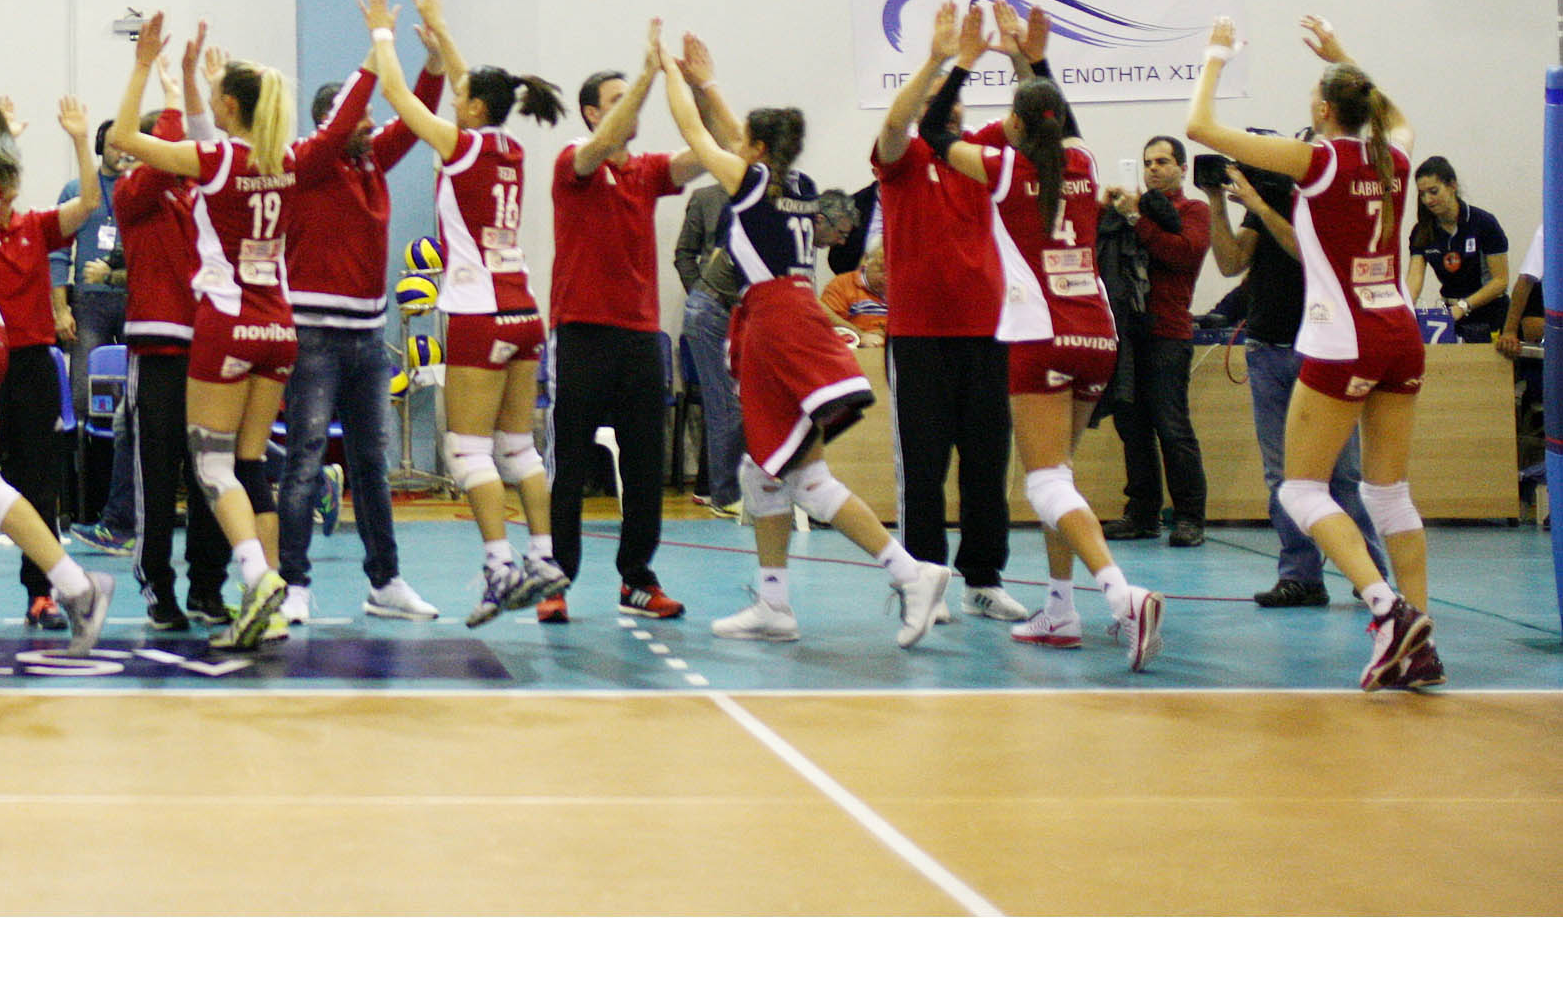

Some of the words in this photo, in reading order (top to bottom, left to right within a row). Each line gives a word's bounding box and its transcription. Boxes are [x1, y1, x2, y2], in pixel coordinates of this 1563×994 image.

[1063, 66, 1159, 84] ΕΝΟΤΗΤΑ
[248, 191, 282, 239] 19
[492, 184, 519, 228] 16
[1051, 199, 1077, 246] 4
[1367, 200, 1383, 253] 7
[1426, 320, 1448, 344] 7
